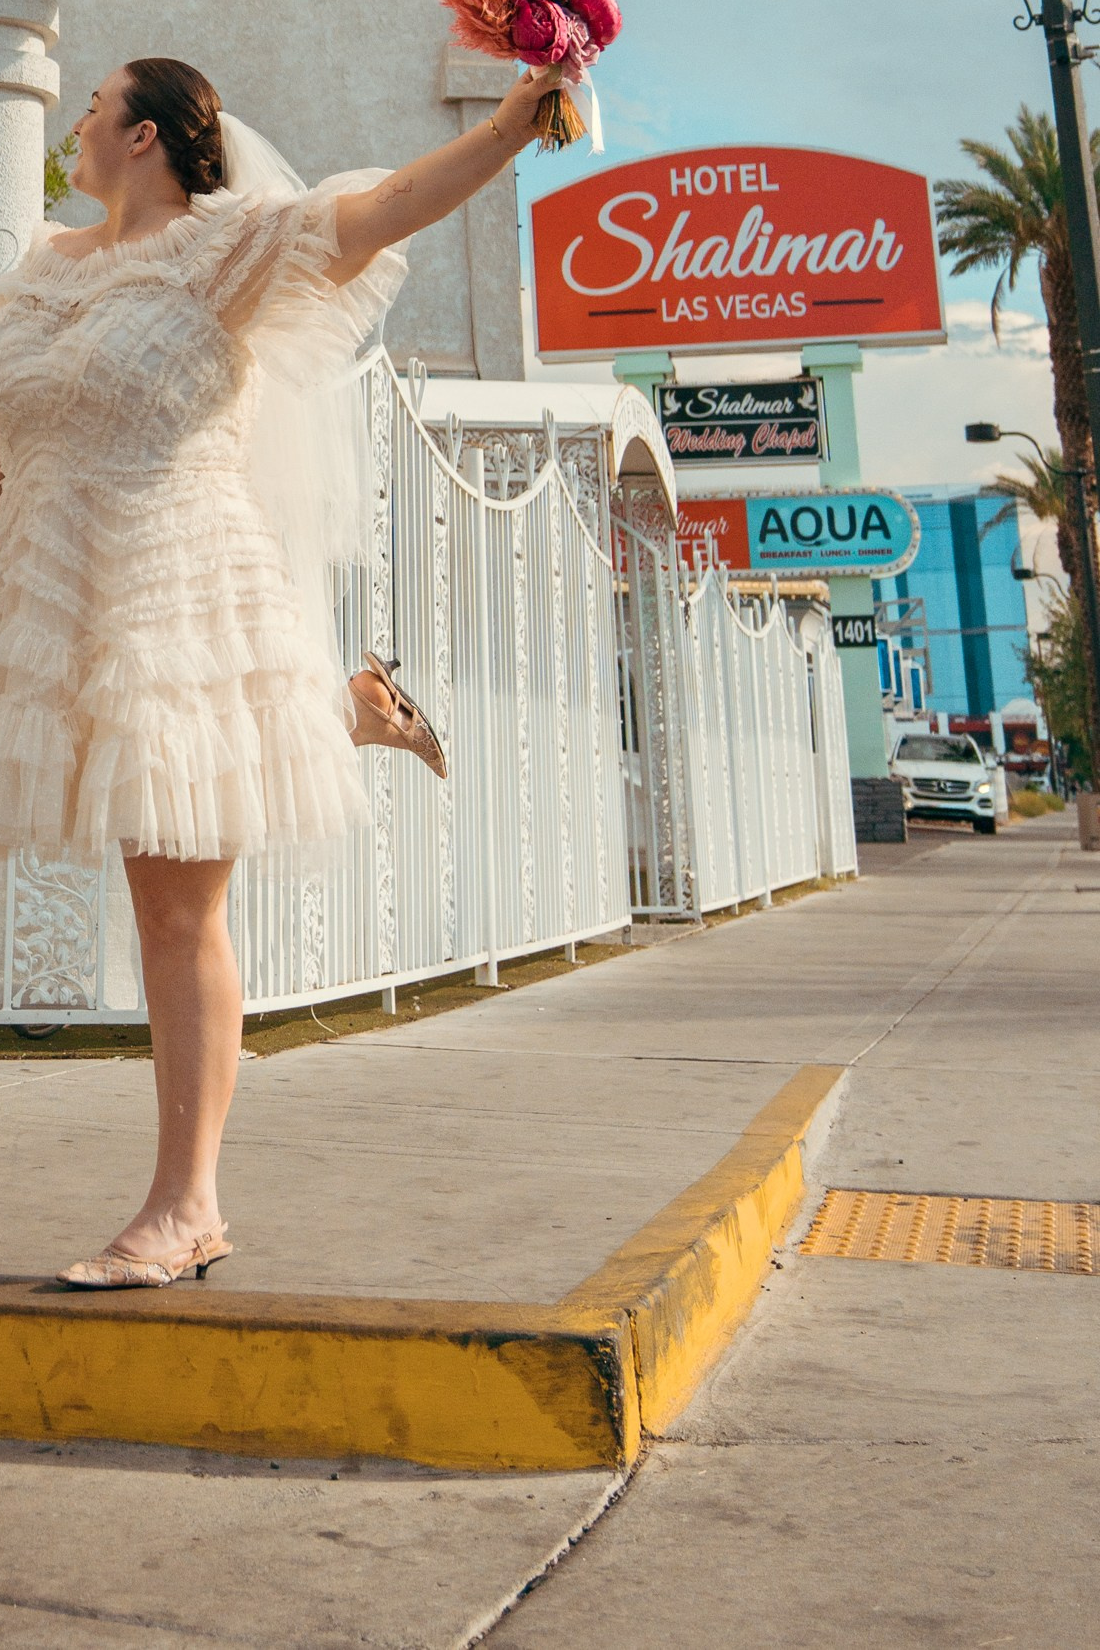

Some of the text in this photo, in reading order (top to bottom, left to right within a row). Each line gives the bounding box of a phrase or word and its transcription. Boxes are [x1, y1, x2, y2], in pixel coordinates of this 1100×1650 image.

[669, 162, 780, 197] HOTEL
[561, 190, 904, 296] Shalimar
[660, 292, 807, 322] LAS VEGAS
[685, 387, 795, 418] Shalimar
[668, 426, 747, 458] Wedding
[751, 422, 816, 455] Chapel
[759, 504, 892, 545] AQUA
[760, 551, 812, 559] BREAKFAST
[858, 548, 892, 556] DINNER
[835, 618, 873, 644] 1401
